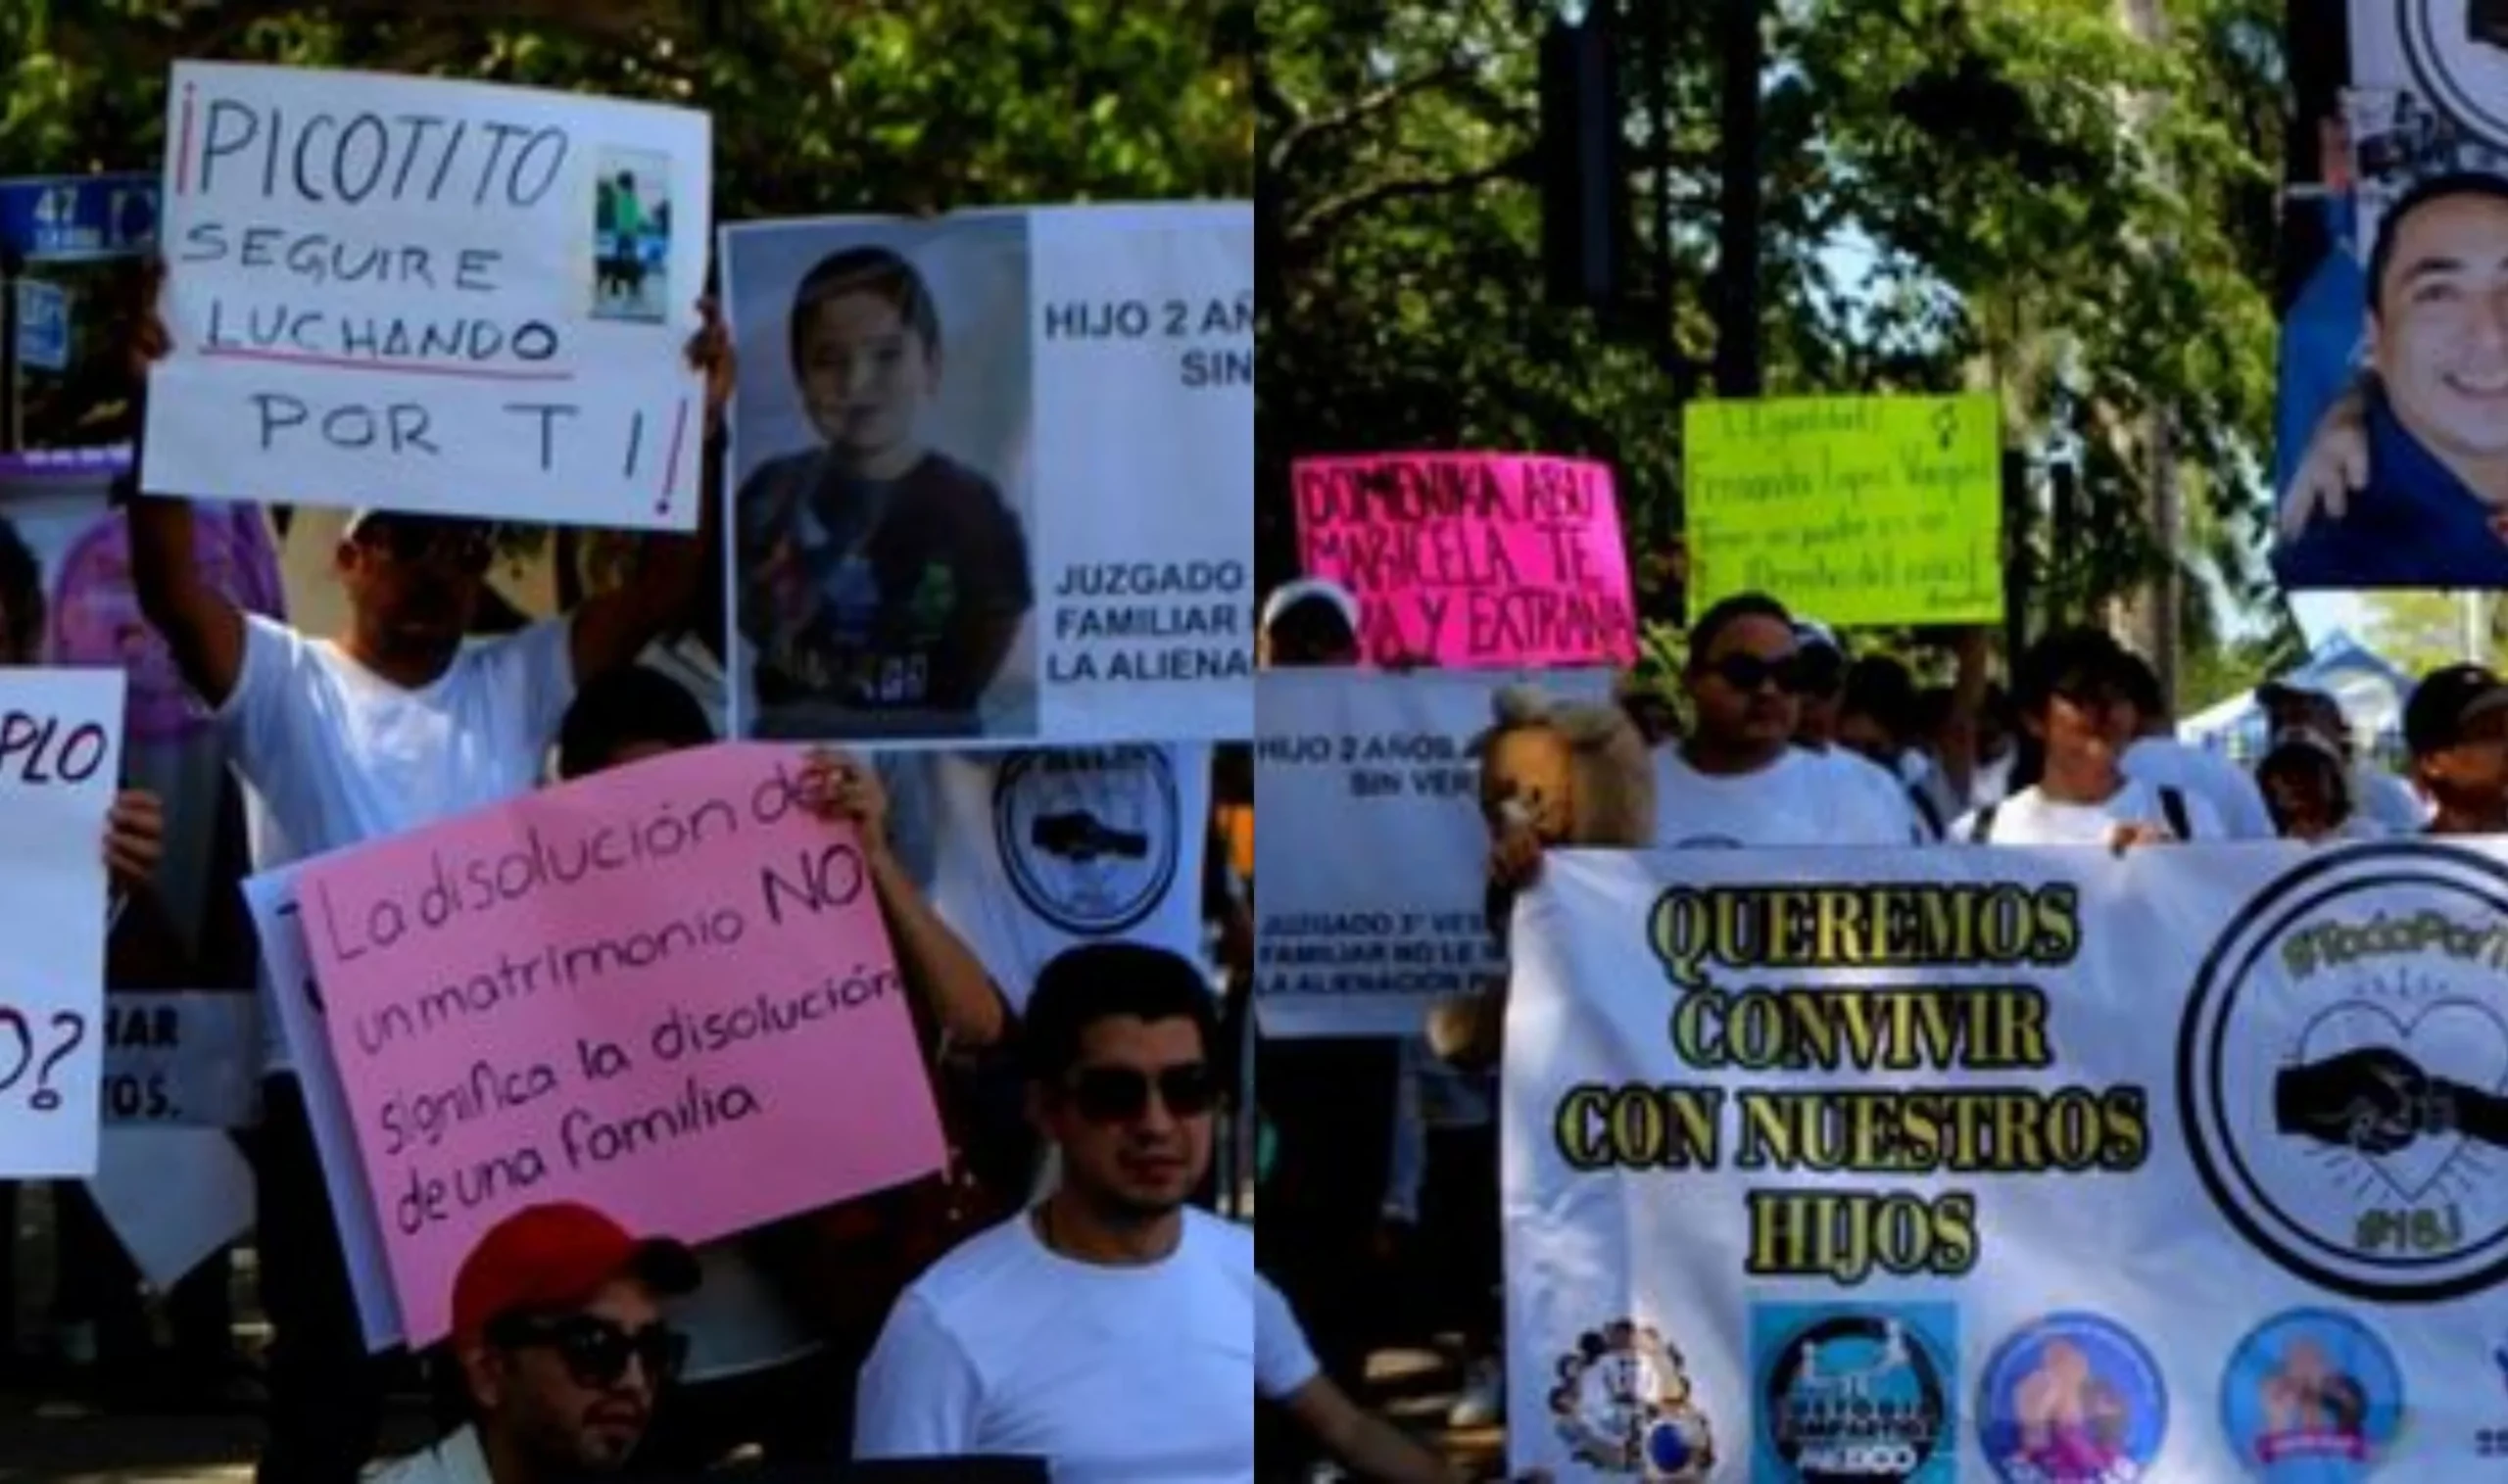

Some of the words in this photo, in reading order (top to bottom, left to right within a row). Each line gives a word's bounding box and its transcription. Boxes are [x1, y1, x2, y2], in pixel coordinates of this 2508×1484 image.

[182, 223, 504, 291] SEGUIRE
[206, 299, 560, 362] LUCHANDO
[1045, 299, 1149, 339] HIJO
[1163, 299, 1188, 336] 2
[1181, 349, 1254, 388] SIN
[251, 394, 441, 456] POR
[1055, 560, 1244, 595] JUZGADO
[1055, 603, 1238, 639] FAMILIAR
[1419, 593, 1449, 665] Y
[1045, 650, 1097, 682] LA
[1258, 736, 1331, 764] HIJO
[419, 805, 739, 931] disolución
[418, 905, 745, 1033] matrimonio
[760, 842, 862, 925] NO
[1648, 883, 2081, 990] QUEREMOS
[1671, 982, 2053, 1072] CONVIVIR
[378, 1059, 557, 1156] significa
[576, 1038, 630, 1079] la
[560, 1078, 760, 1170] familia
[1555, 1084, 1723, 1171] CON
[1736, 1084, 2150, 1173] NUESTROS
[1746, 1187, 1980, 1284] HIJOS
